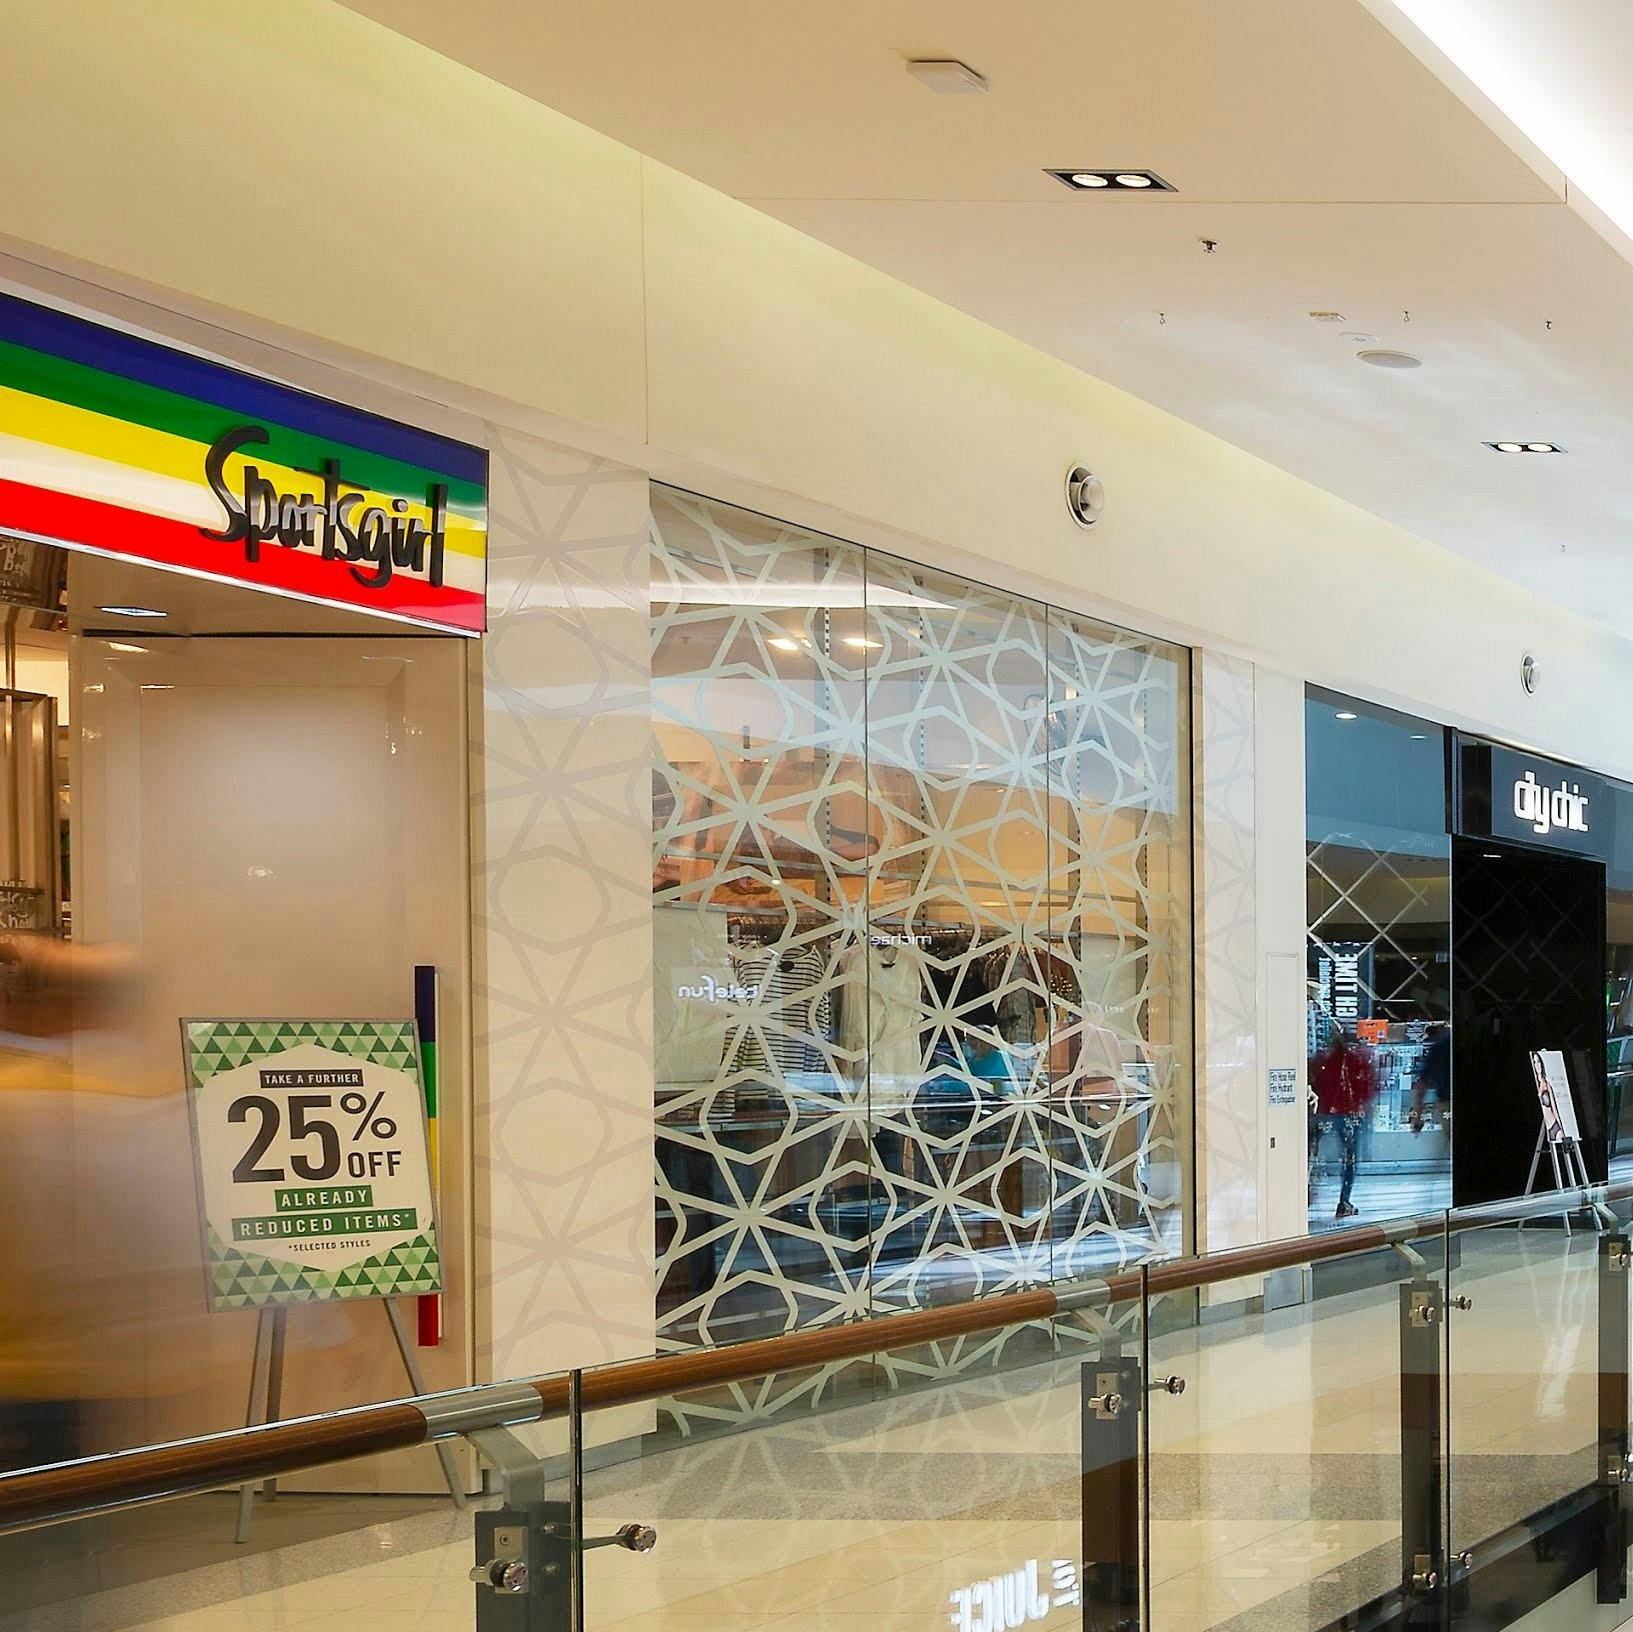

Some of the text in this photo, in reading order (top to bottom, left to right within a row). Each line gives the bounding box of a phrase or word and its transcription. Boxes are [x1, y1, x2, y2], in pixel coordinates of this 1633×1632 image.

[200, 425, 448, 588] Sportsgirl
[264, 1072, 359, 1085] TAKE A FURTHER
[227, 1090, 399, 1184] 25%
[347, 1150, 402, 1179] OFF
[281, 1189, 368, 1208] ALREADY
[240, 1217, 334, 1237] REDUCED
[340, 1239, 372, 1249] STYLES
